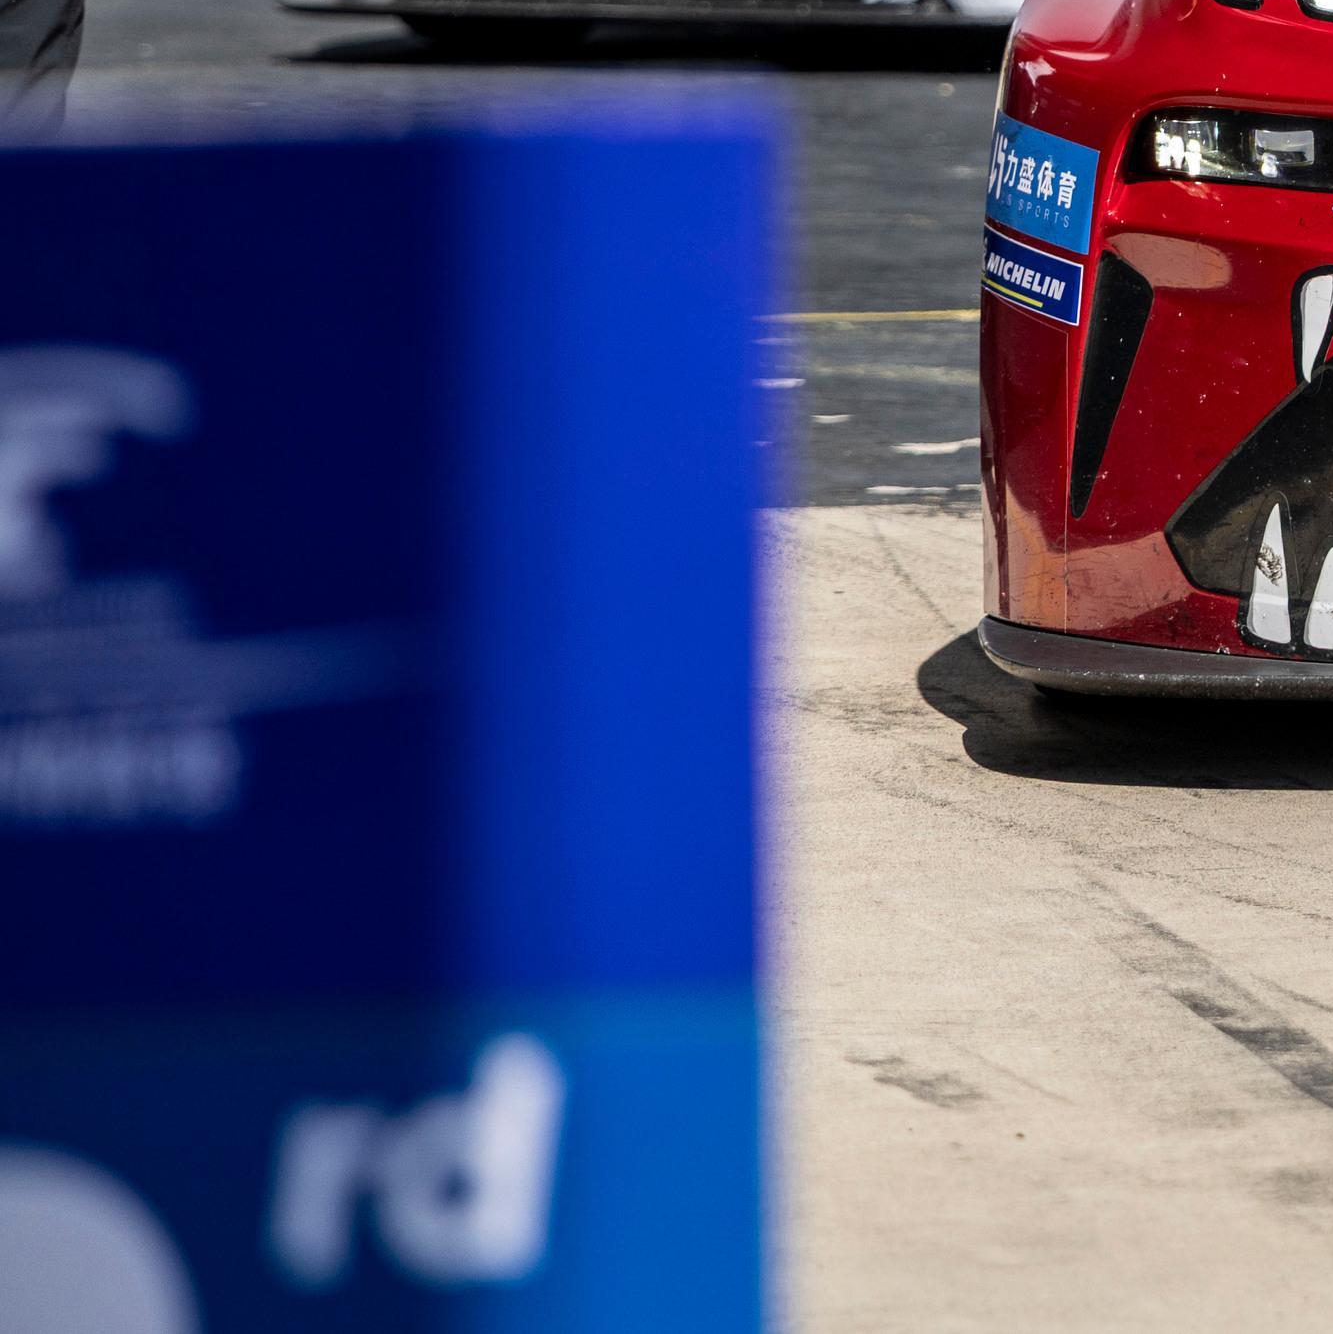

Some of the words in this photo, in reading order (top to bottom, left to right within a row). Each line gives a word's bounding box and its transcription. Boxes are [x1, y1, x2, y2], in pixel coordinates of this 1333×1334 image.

[1004, 150, 1078, 209] 力盛体育
[1018, 198, 1070, 228] SPORTS
[987, 251, 1066, 301] MICHELIN
